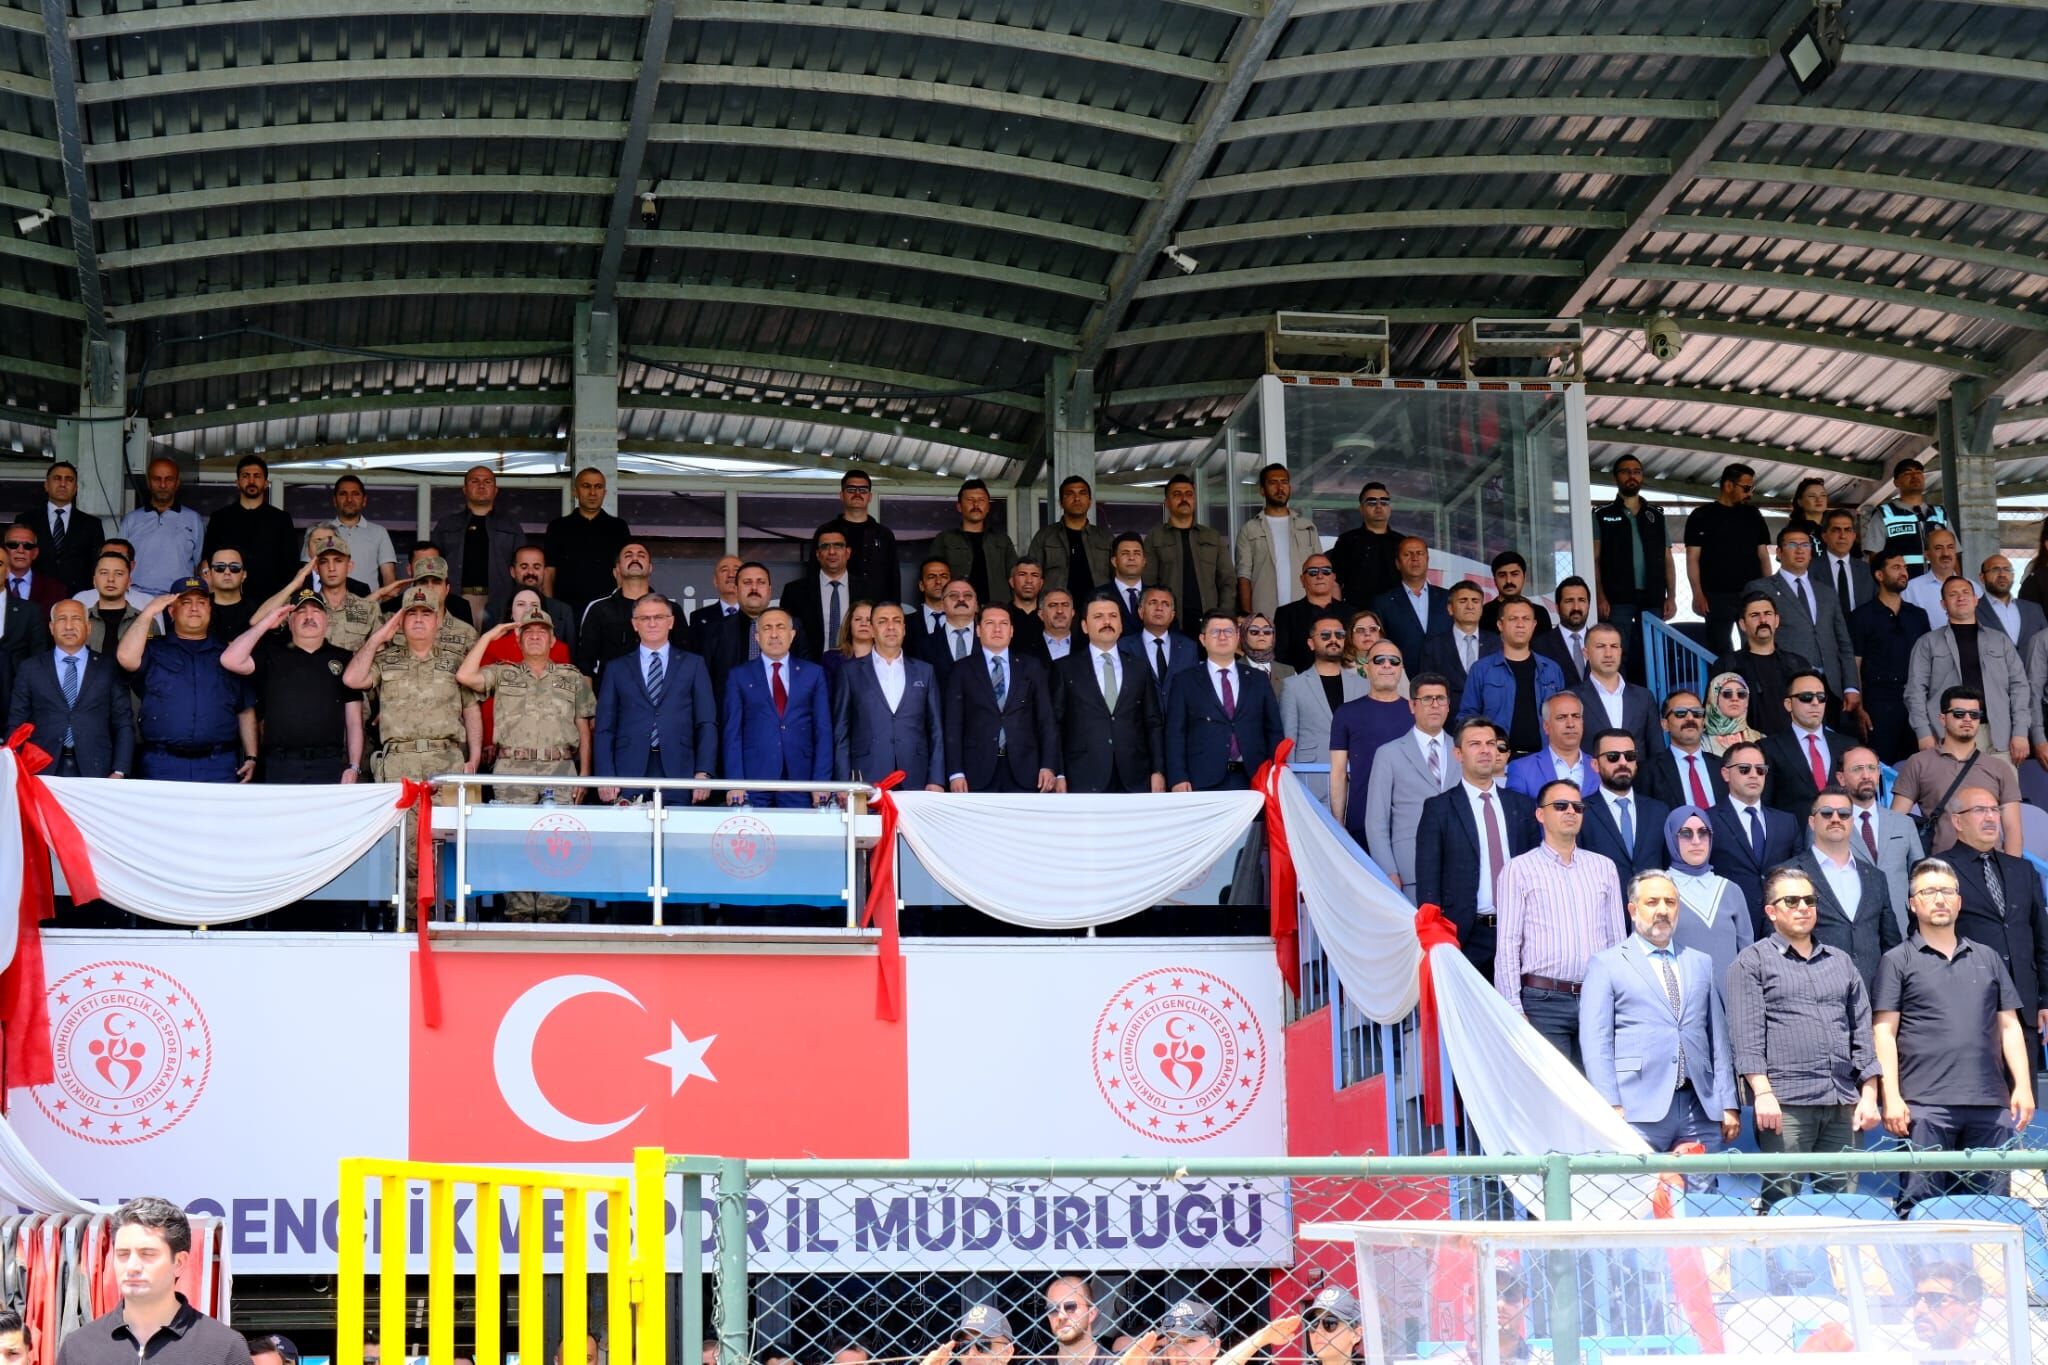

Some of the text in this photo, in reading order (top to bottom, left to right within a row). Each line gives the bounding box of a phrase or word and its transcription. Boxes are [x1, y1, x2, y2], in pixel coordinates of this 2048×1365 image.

[101, 994, 152, 1012] GENÇLİK
[152, 1008, 166, 1024] VE
[1162, 999, 1209, 1016] GENÇLİK
[1209, 1012, 1222, 1027] VE
[162, 1023, 177, 1054] SPOR
[1218, 1026, 1234, 1056] SPOR
[131, 1057, 177, 1109] BAKANLIĞI
[1196, 1058, 1234, 1109] BAKANLIĞI
[786, 1186, 839, 1253] İL
[854, 1183, 1263, 1253] MÜDÜRLÜĞÜ
